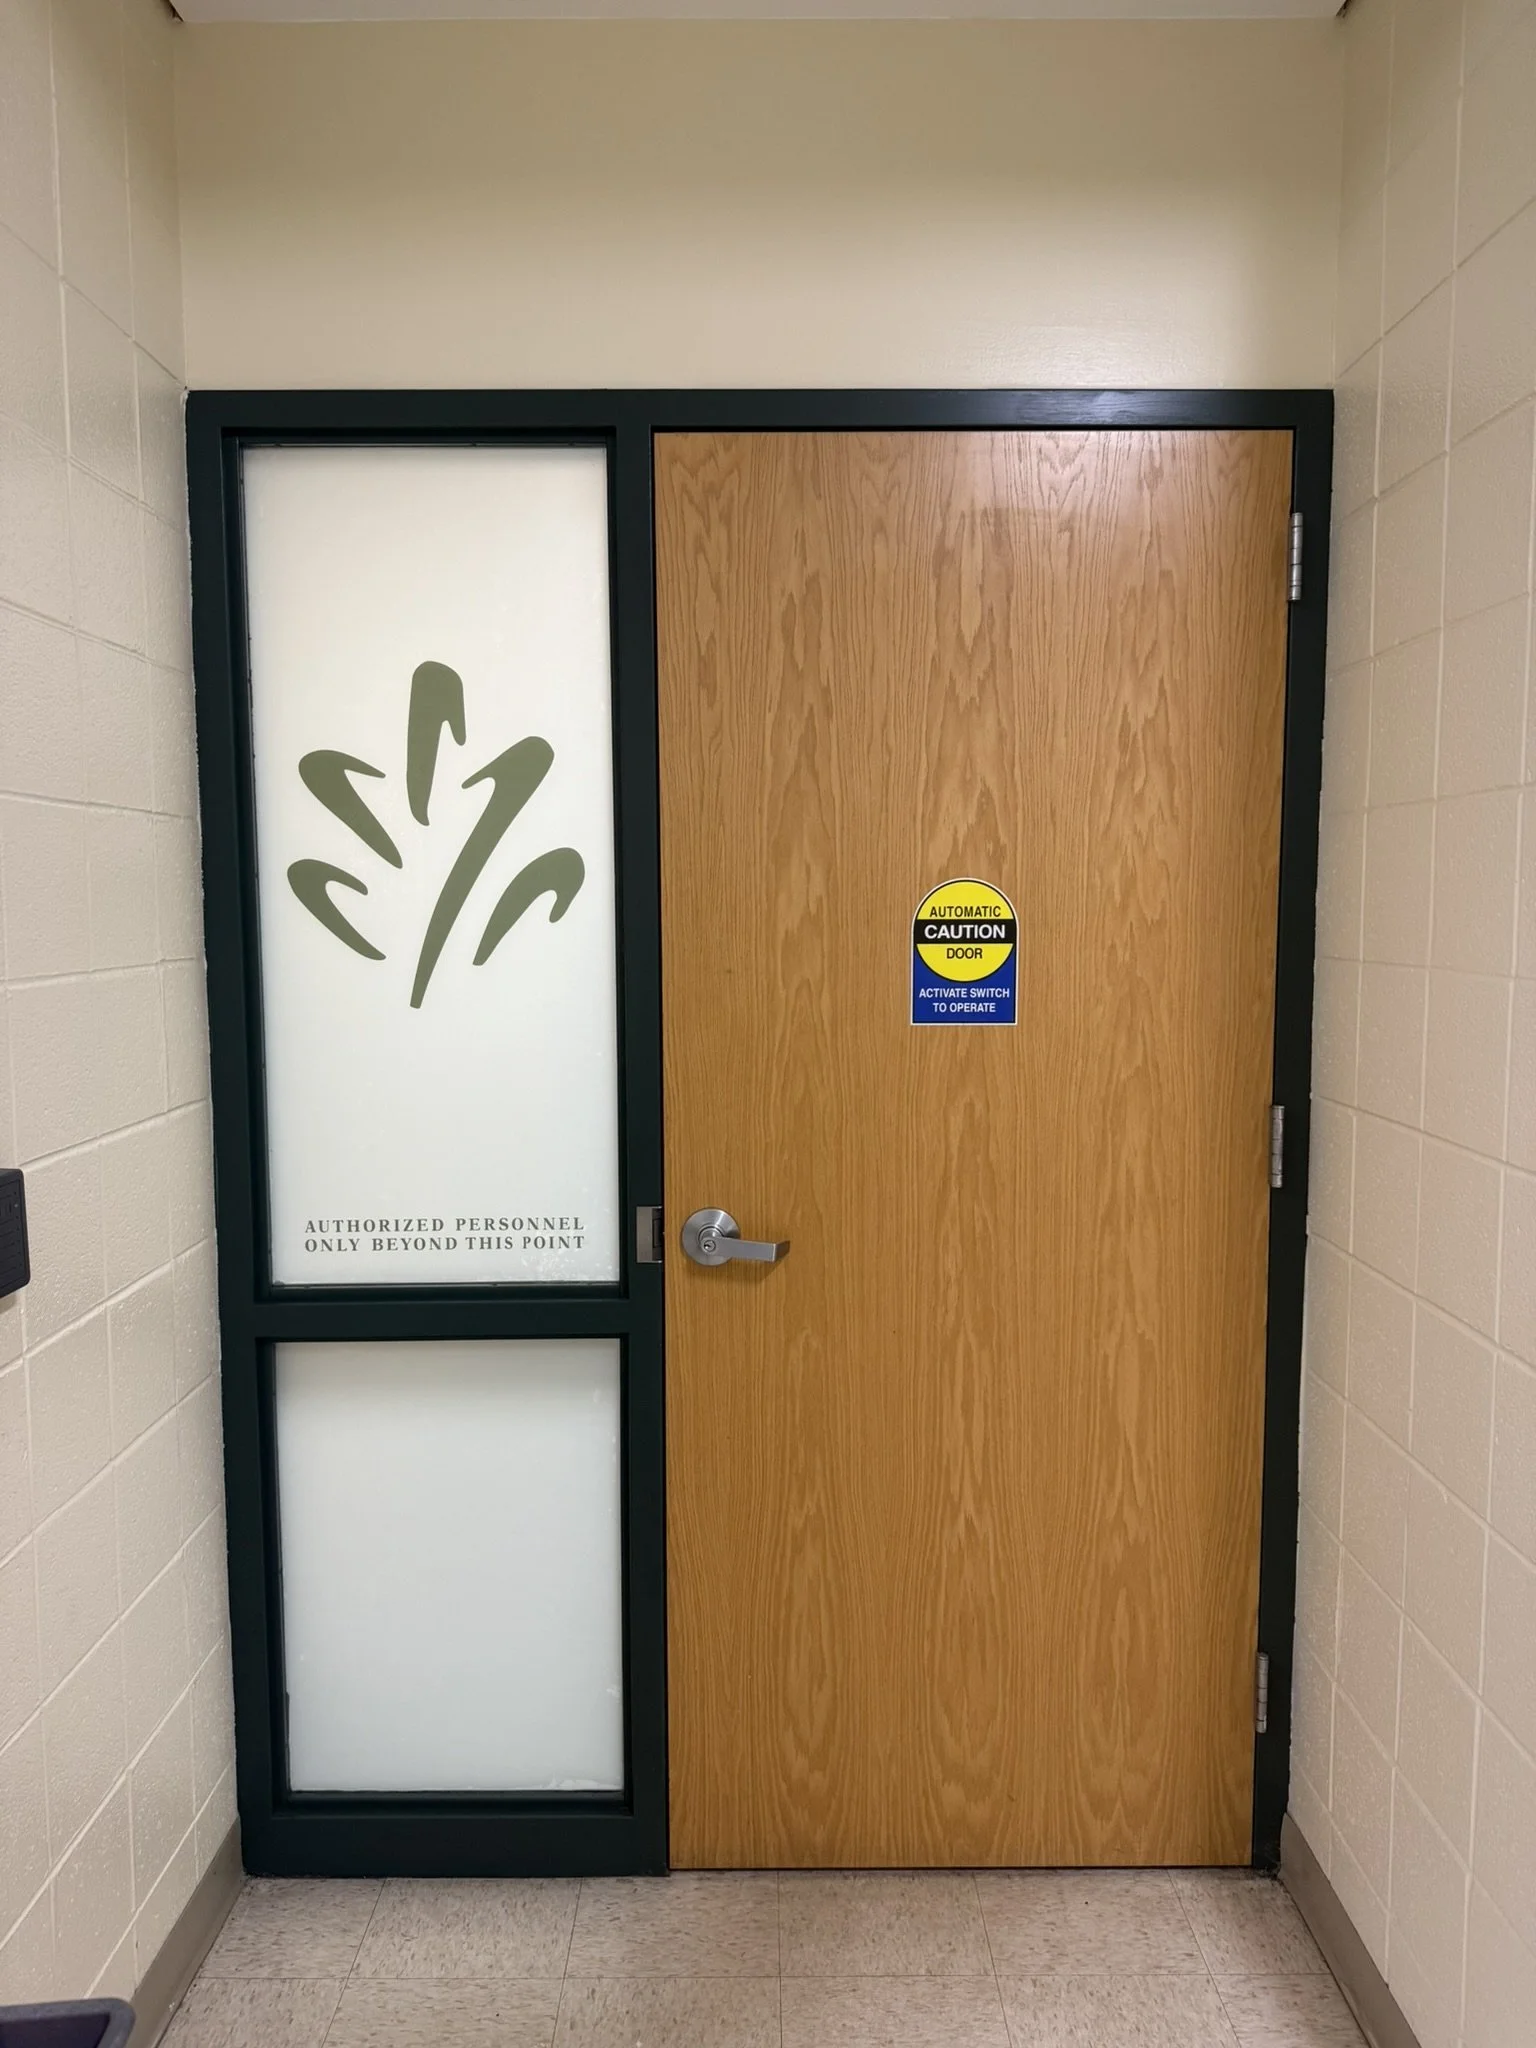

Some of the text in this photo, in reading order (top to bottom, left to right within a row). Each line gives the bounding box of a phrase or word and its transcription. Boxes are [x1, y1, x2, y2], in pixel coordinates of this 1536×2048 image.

[929, 906, 1001, 917] AUTOMATIC
[924, 924, 1006, 939] CAUTION
[946, 948, 983, 959] DOOR
[919, 988, 1010, 998] ACTIVATE SWITCH
[933, 1003, 996, 1013] TO OPERATE
[304, 1217, 585, 1234] AUTHORIZED PERSONNEL
[304, 1235, 585, 1252] ONLY BEYOND THIS POINT
